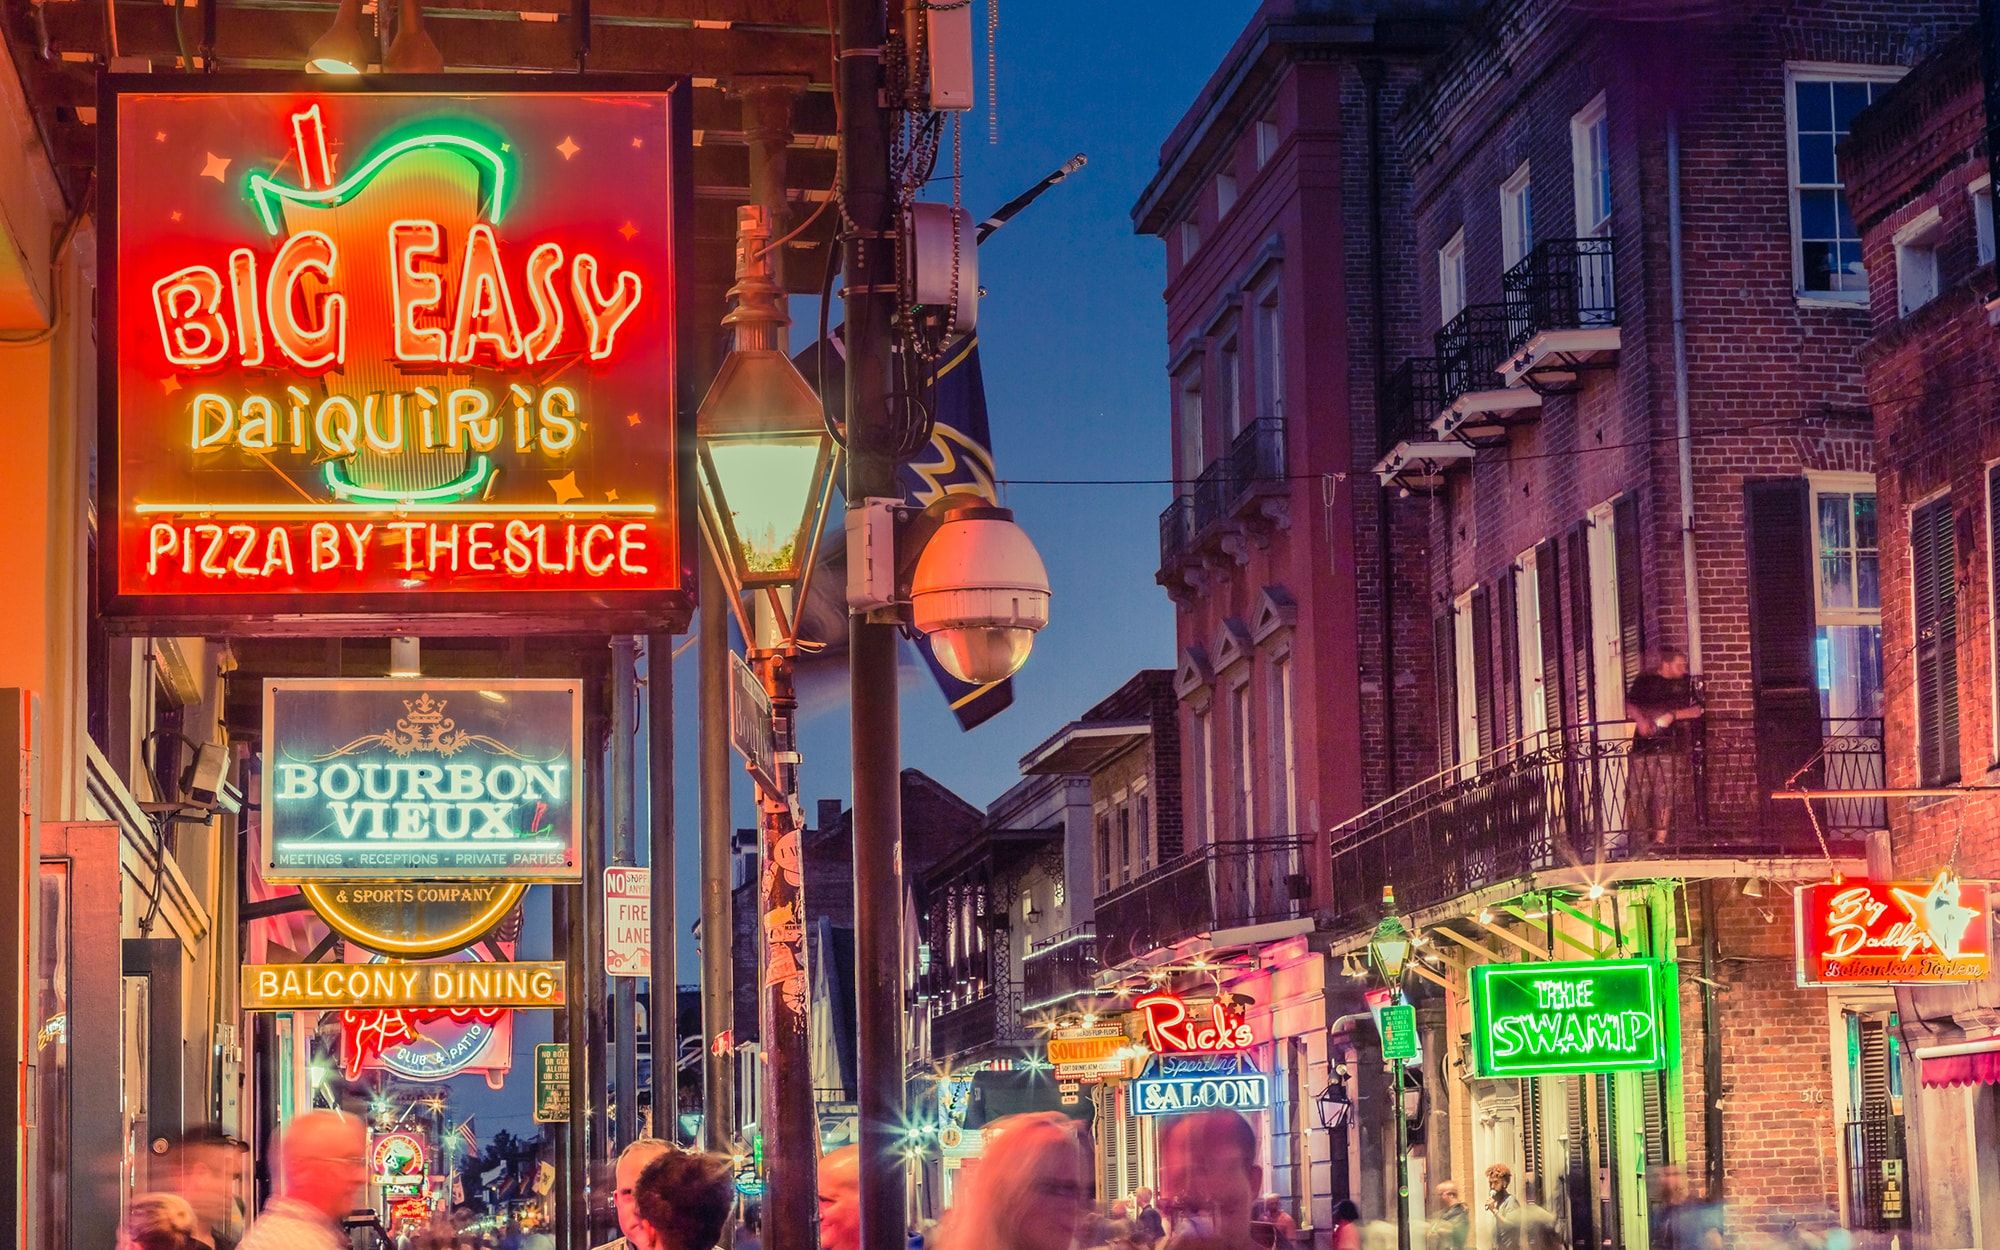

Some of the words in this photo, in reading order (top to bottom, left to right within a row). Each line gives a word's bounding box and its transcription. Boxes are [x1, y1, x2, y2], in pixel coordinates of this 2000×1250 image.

[152, 230, 346, 367] BIG
[388, 219, 643, 365] EASY
[147, 522, 295, 577] PIZZA
[311, 521, 373, 573] BY
[277, 763, 568, 800] BOURBON
[326, 801, 519, 839] VIEUX
[279, 854, 343, 865] MEETINGS
[360, 853, 439, 865] RECEPTIONS
[456, 853, 507, 865] PRIVATE
[513, 853, 565, 864] PARTIES
[336, 891, 349, 903] &
[353, 889, 413, 903] SPORTS
[418, 887, 496, 903] COMPANY
[607, 874, 625, 893] NO
[619, 904, 648, 920] FIRE
[1829, 887, 1888, 926] Big
[617, 927, 651, 943] LANE
[259, 970, 419, 999] BALCONY
[434, 971, 553, 999] DINING
[1533, 980, 1594, 1009] THE
[1136, 997, 1253, 1052] Rick's
[1493, 1010, 1652, 1056] SWAMP
[397, 1049, 426, 1065] CLUB
[436, 1052, 445, 1063] &
[450, 1024, 481, 1059] PATIO
[1164, 1055, 1237, 1077] Sporting
[1145, 1080, 1260, 1109] SALOON
[1801, 1089, 1824, 1104] 516
